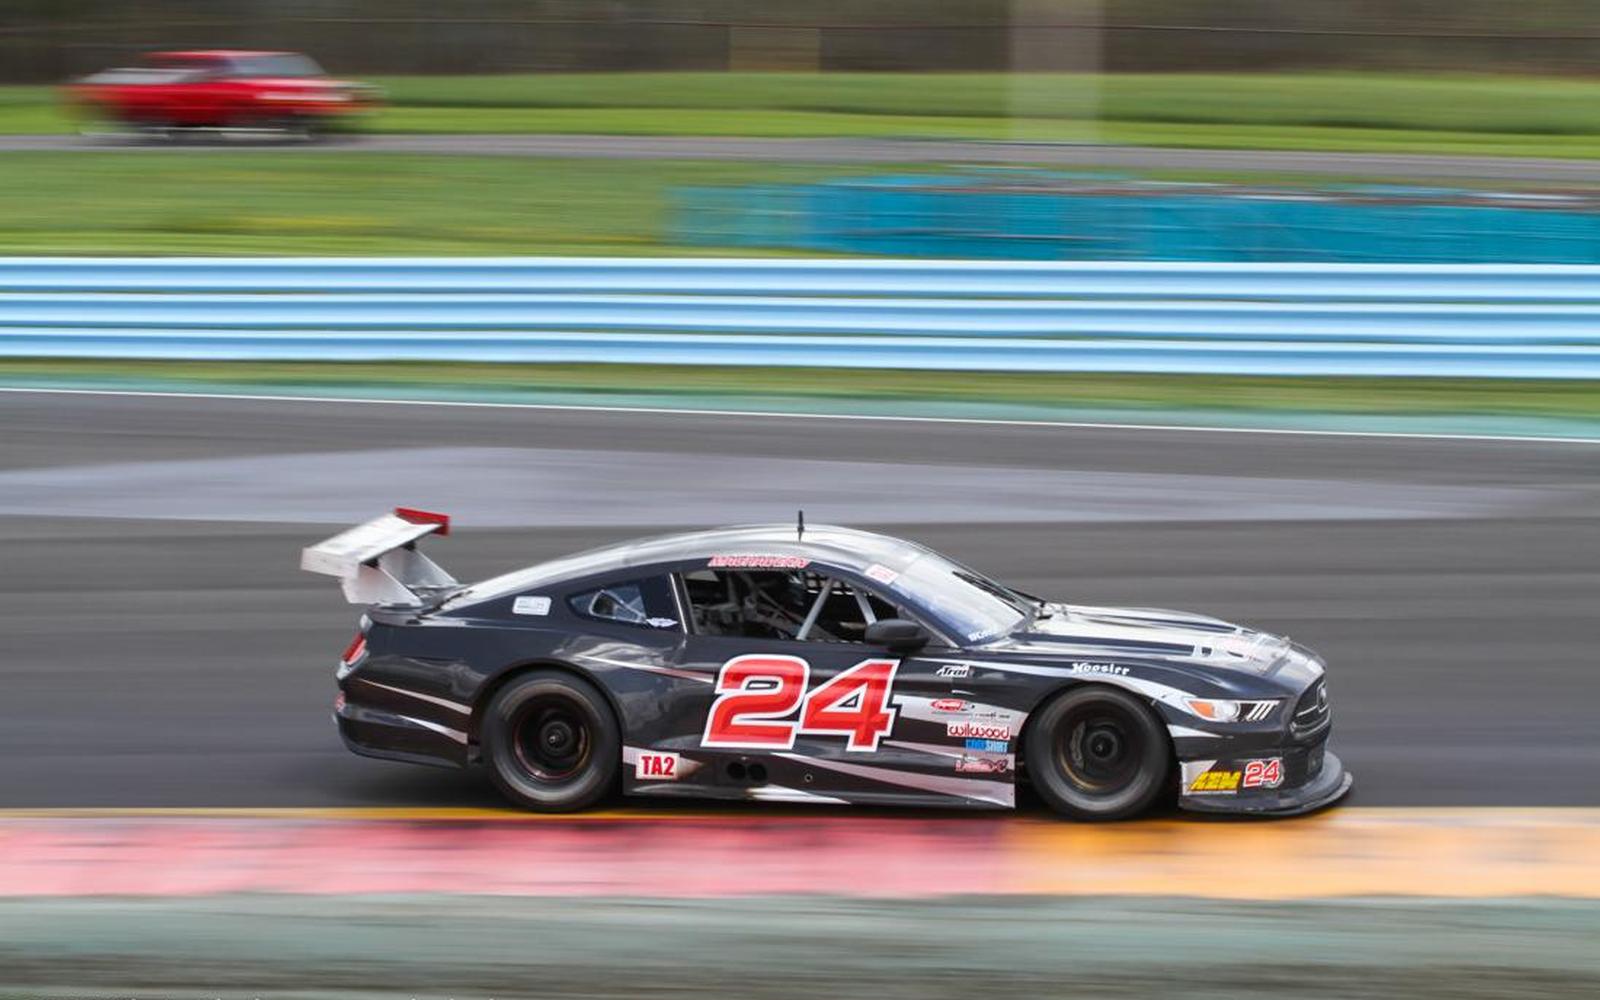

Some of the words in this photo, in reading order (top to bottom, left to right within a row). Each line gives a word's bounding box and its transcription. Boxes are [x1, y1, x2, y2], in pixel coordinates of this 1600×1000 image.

[1072, 663, 1130, 676] Hoosier
[701, 654, 900, 753] 24
[949, 723, 1010, 739] wilwood
[641, 755, 675, 776] TA2
[1243, 760, 1280, 787] 24
